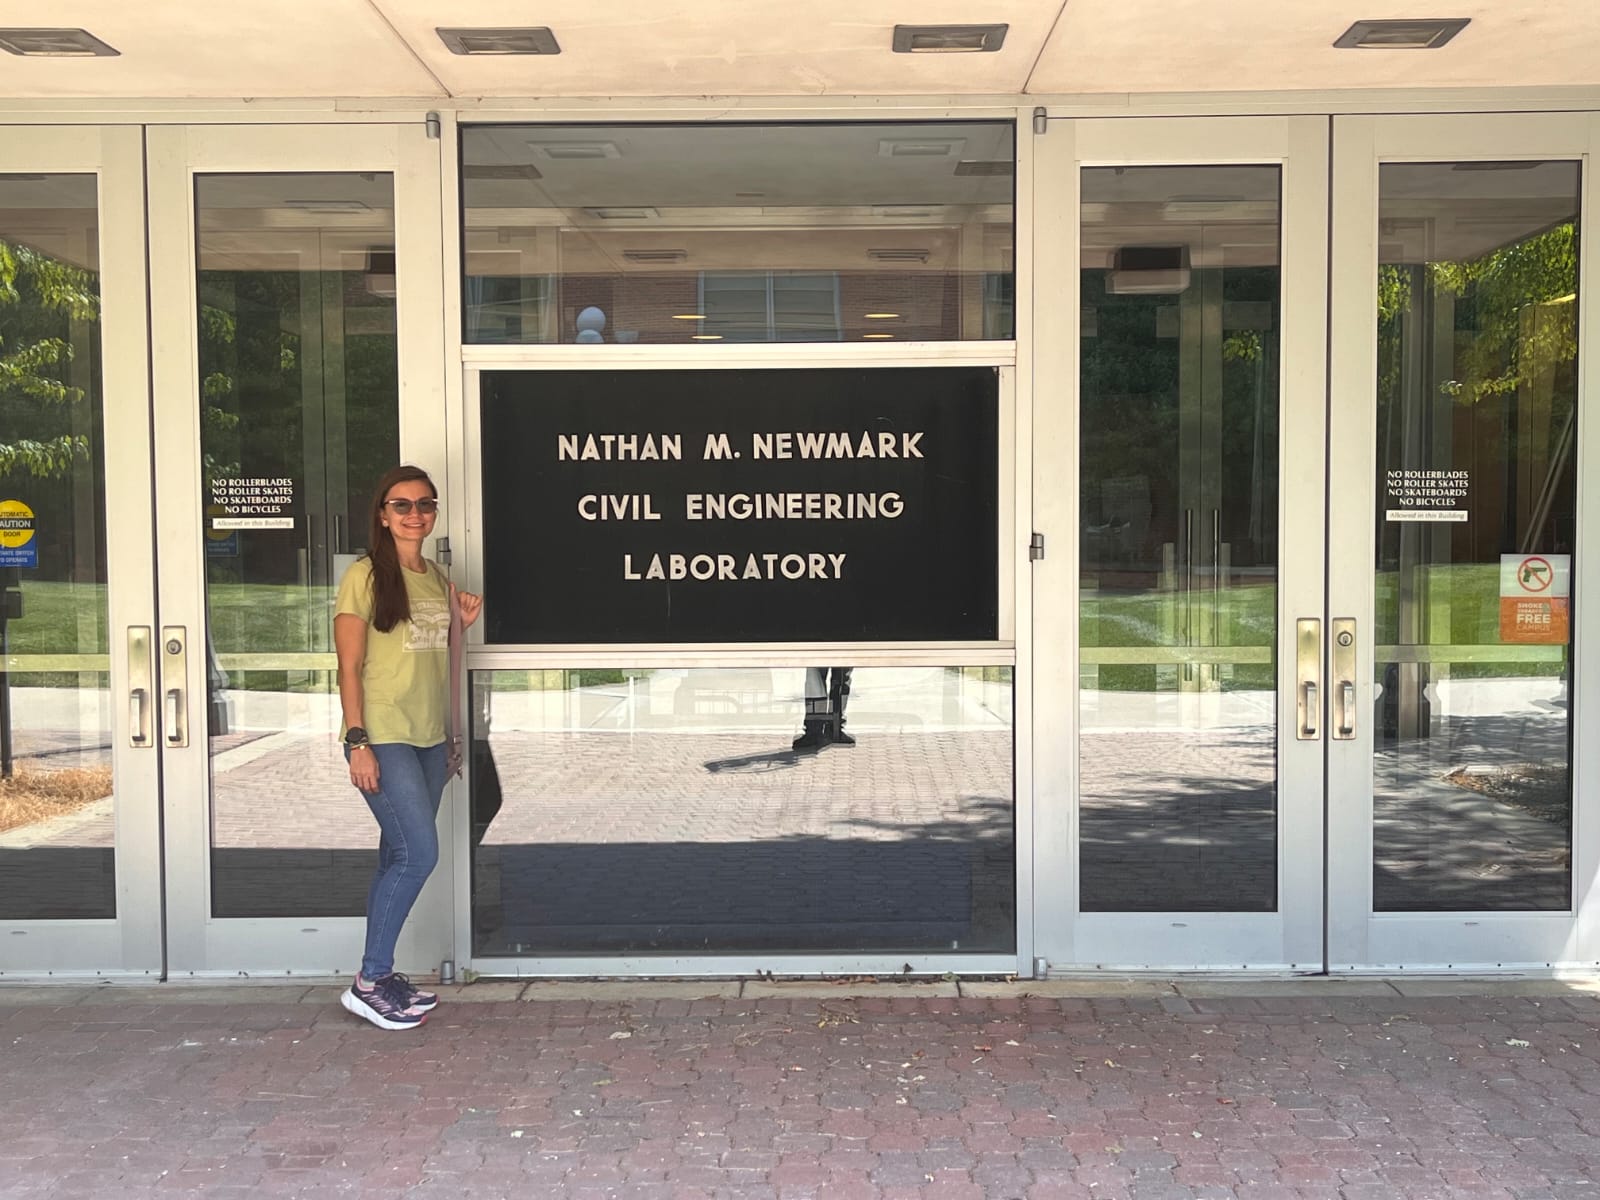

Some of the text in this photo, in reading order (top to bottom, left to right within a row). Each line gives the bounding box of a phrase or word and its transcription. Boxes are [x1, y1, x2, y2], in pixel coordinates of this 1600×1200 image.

[558, 431, 925, 461] NATHAN M. NEWMARK
[1387, 470, 1469, 479] NO ROLLERBLADES
[228, 478, 293, 487] ROLLERBLADES
[1387, 479, 1469, 488] NO ROLLER SKATES
[212, 487, 293, 496] NO ROLLER SKATES
[1388, 488, 1467, 497] NO SKATEBOARDS
[213, 496, 229, 505] NO
[1399, 497, 1456, 506] NO BICYCLES
[224, 505, 282, 514] NO BICYCLES
[577, 493, 905, 521] CIVIL ENGINEERING
[1438, 511, 1465, 520] Building
[264, 519, 291, 528] Building
[624, 553, 847, 581] LABORATORY
[1516, 613, 1551, 624] FREE
